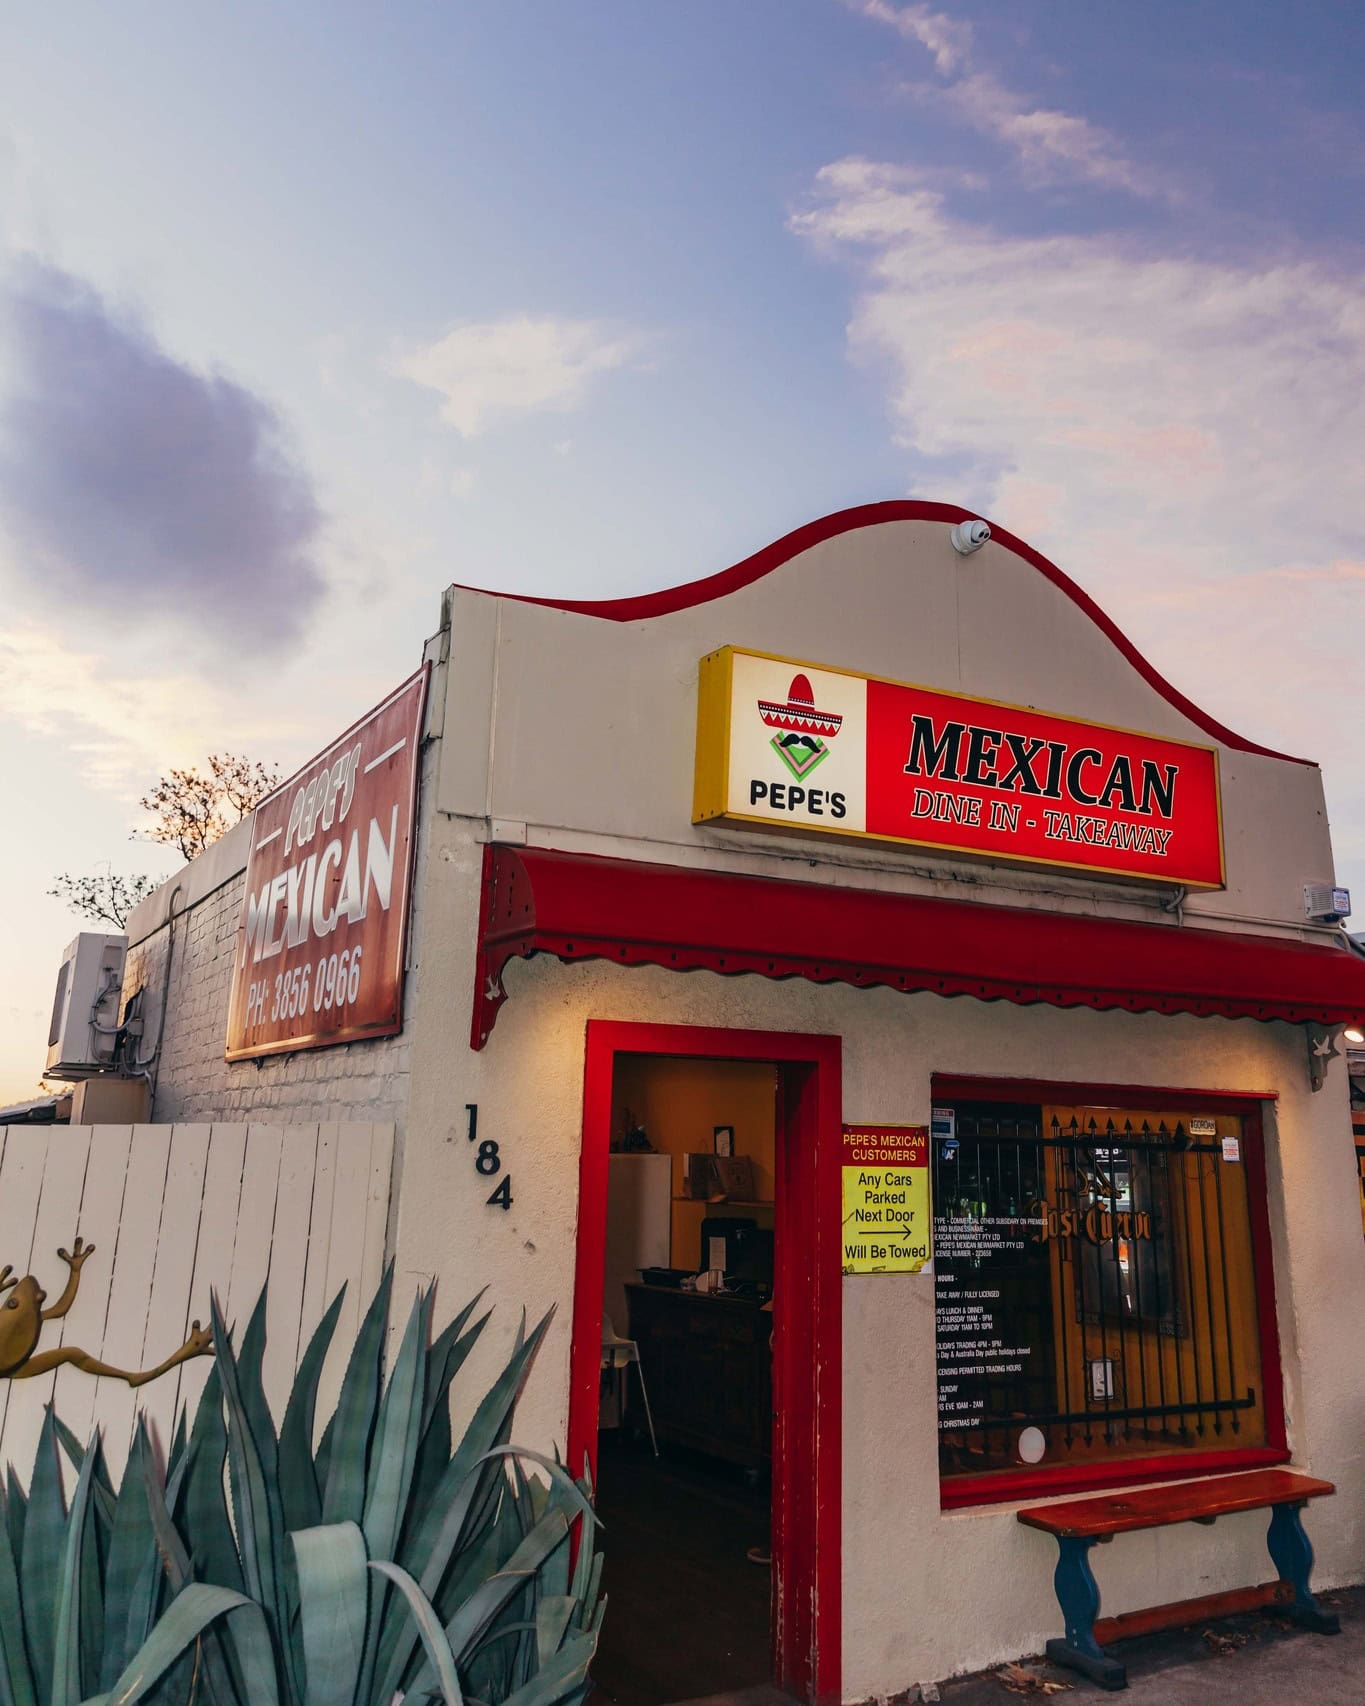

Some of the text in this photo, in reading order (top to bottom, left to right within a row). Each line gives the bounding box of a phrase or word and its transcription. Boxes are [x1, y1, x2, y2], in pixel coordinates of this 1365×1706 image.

[903, 714, 1179, 819] MEXICAN
[283, 742, 362, 857] PEPE'S
[750, 779, 847, 819] PEPE'S
[911, 788, 982, 827] DINE
[988, 801, 1021, 832] IN
[1043, 810, 1173, 856] TAKEAWAY
[241, 804, 400, 968] MEXICAN
[245, 945, 362, 1029] PH: 3856 0966
[843, 1134, 925, 1147] PEPE'S MEXICAN
[852, 1149, 917, 1161] CUSTOMERS
[858, 1172, 912, 1189] Any Cars
[865, 1190, 906, 1204] Parked
[855, 1208, 915, 1222] Next Door
[845, 1244, 926, 1259] Will Be Towed
